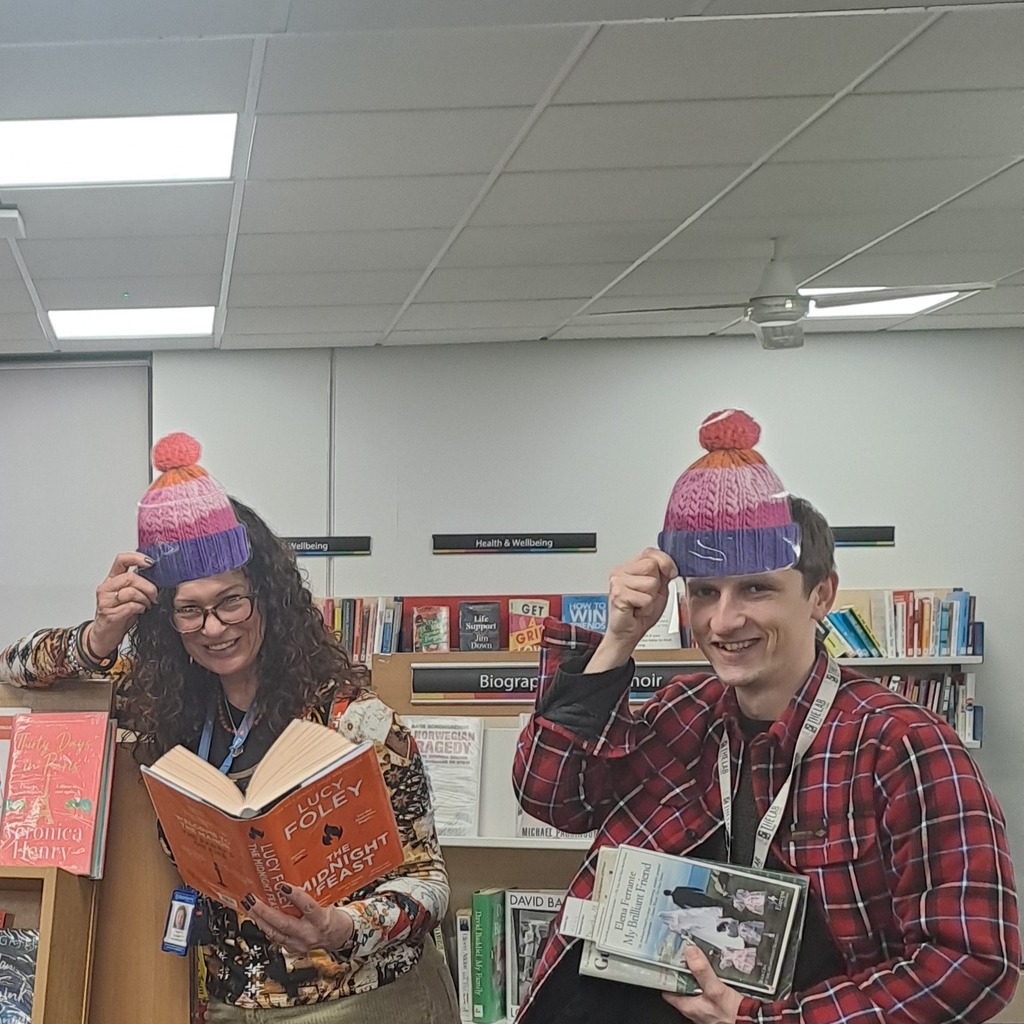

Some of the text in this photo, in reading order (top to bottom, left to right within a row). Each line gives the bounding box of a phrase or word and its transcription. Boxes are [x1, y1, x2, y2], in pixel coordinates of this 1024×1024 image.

[476, 539, 502, 548] Health
[512, 538, 553, 549] Wellbeing
[521, 604, 544, 616] GET
[569, 609, 606, 623] WIN
[465, 622, 496, 631] Support
[474, 615, 489, 623] Life
[528, 617, 536, 627] A
[570, 622, 606, 630] IENDS
[475, 634, 488, 642] Jim
[515, 626, 544, 644] GRI
[470, 641, 492, 649] Down
[480, 674, 538, 691] Biograp
[17, 731, 92, 756] Thirty Days
[414, 730, 475, 741] NORWEGIAN
[417, 741, 471, 754] RAGEDY
[297, 777, 344, 815] LUCY
[283, 779, 364, 842] FOLEY
[522, 827, 553, 837] MICHAEL
[12, 841, 71, 861] Henry
[260, 843, 281, 872] LUCY
[326, 843, 351, 862] THE
[300, 832, 390, 893] MIDNIGHT
[248, 844, 261, 858] THE
[266, 893, 280, 910] FEAS
[315, 854, 376, 897] FEAST
[636, 862, 652, 893] Friend
[510, 895, 563, 908] DAVID BA
[615, 871, 637, 931] Elena Ferrante
[627, 893, 645, 929] Brilliant
[623, 929, 639, 945] My
